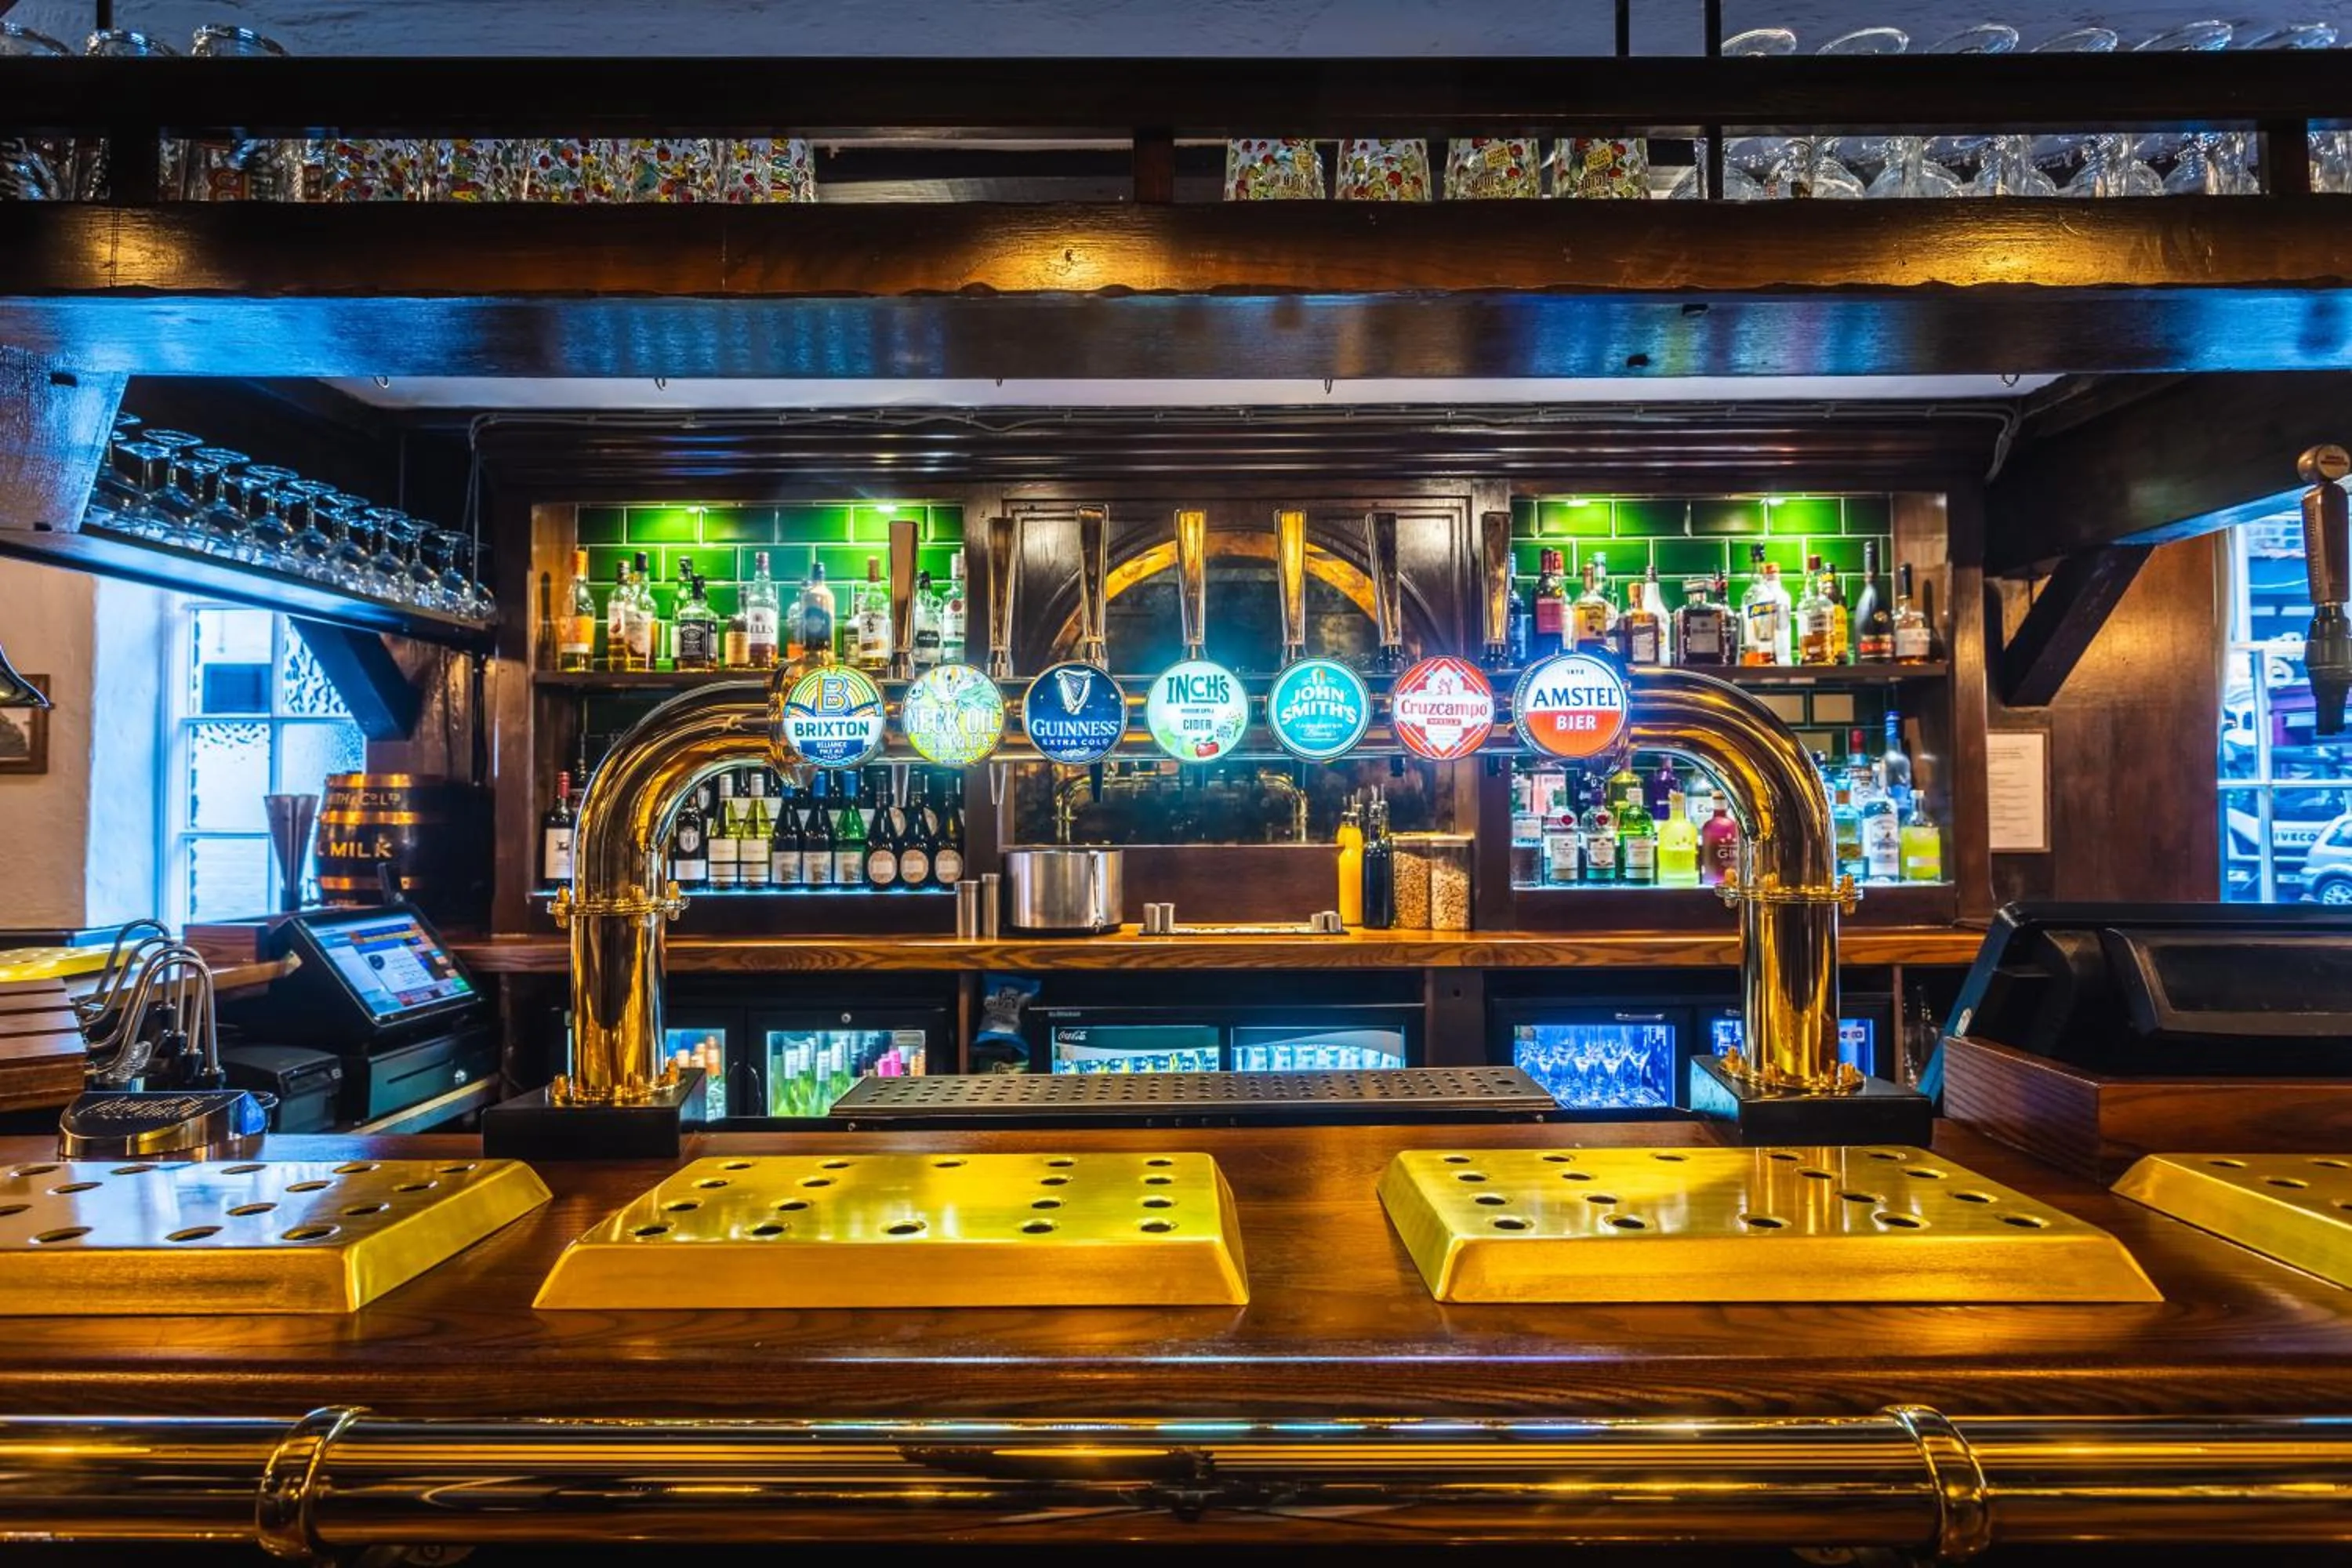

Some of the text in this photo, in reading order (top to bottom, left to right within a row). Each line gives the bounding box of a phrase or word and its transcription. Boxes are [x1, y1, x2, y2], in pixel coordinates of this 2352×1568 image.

[1167, 673, 1229, 704] INCH'S
[1290, 685, 1345, 705] JOHN
[1533, 688, 1617, 707] AMSTEL
[1280, 701, 1357, 725] SMITH'S
[1401, 699, 1488, 718] Cruzcampo
[794, 720, 869, 736] BRIXTON
[905, 707, 998, 733] NECK OIL
[1031, 719, 1120, 736] GUINNESS
[1183, 719, 1213, 730] CIDER
[1556, 714, 1596, 731] BIER
[2274, 831, 2317, 842] IVECO
[330, 841, 392, 857] MILK
